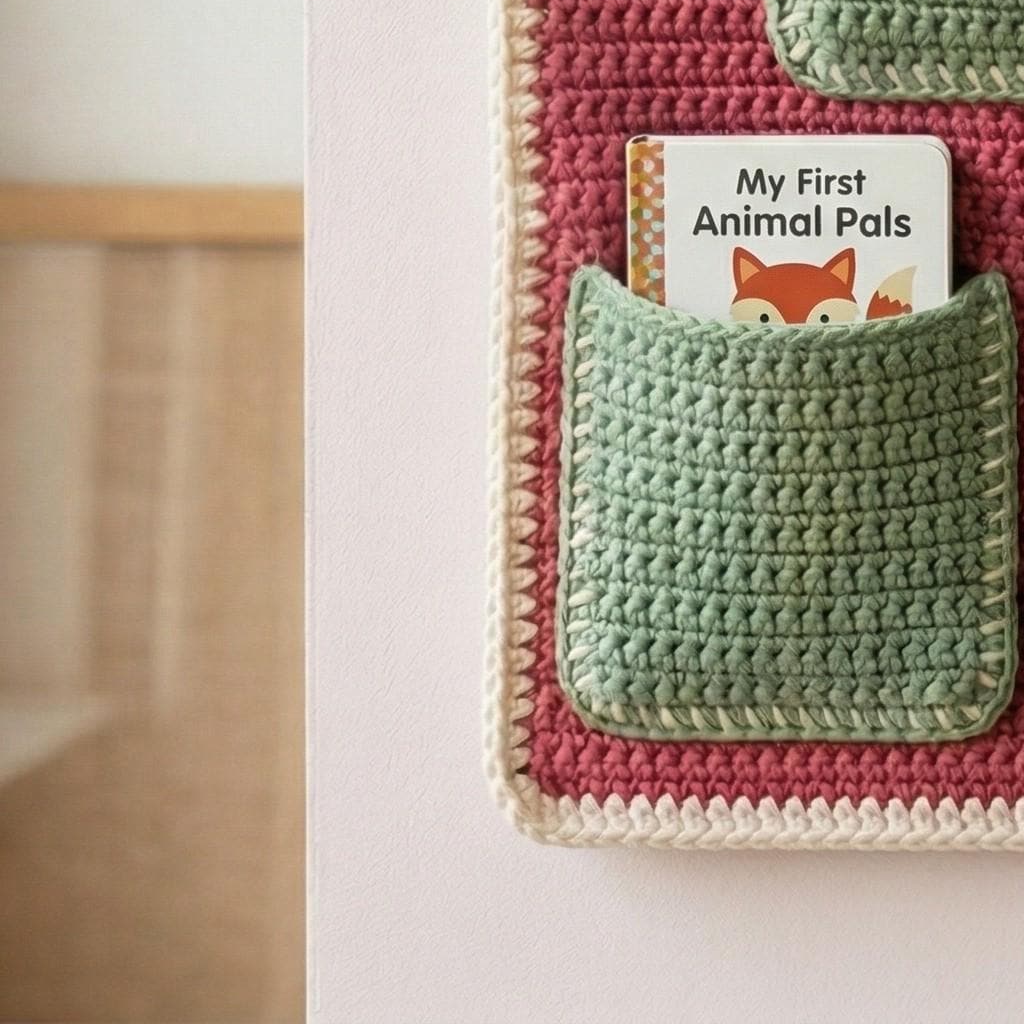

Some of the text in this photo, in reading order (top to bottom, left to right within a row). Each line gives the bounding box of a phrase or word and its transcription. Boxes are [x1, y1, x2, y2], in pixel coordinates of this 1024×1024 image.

[736, 167, 867, 202] My First
[692, 204, 912, 238] Animal Pals
